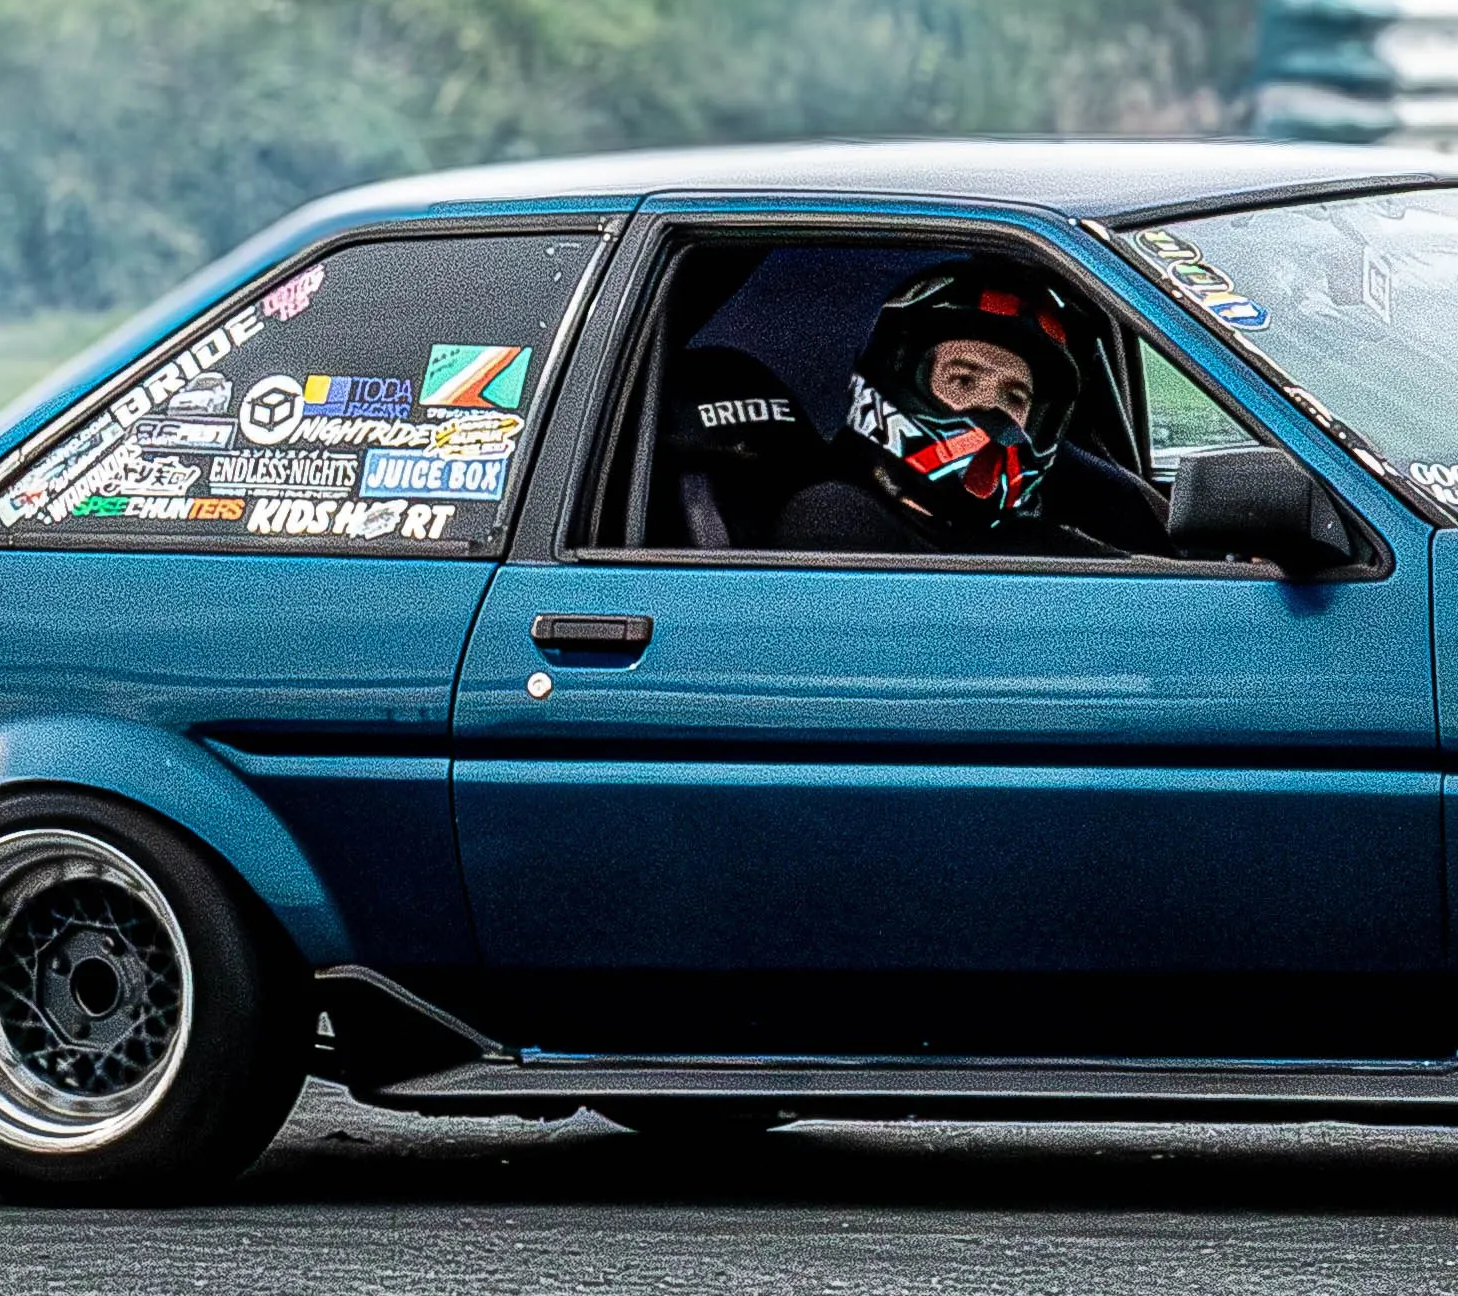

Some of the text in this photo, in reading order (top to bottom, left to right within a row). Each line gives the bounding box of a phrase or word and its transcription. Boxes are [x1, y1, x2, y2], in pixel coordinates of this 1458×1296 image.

[110, 306, 265, 428] BRIDE
[350, 376, 412, 404] TODA
[698, 398, 796, 428] BRIDE
[366, 458, 502, 492] JUICE BOX
[246, 498, 337, 535] KIDS
